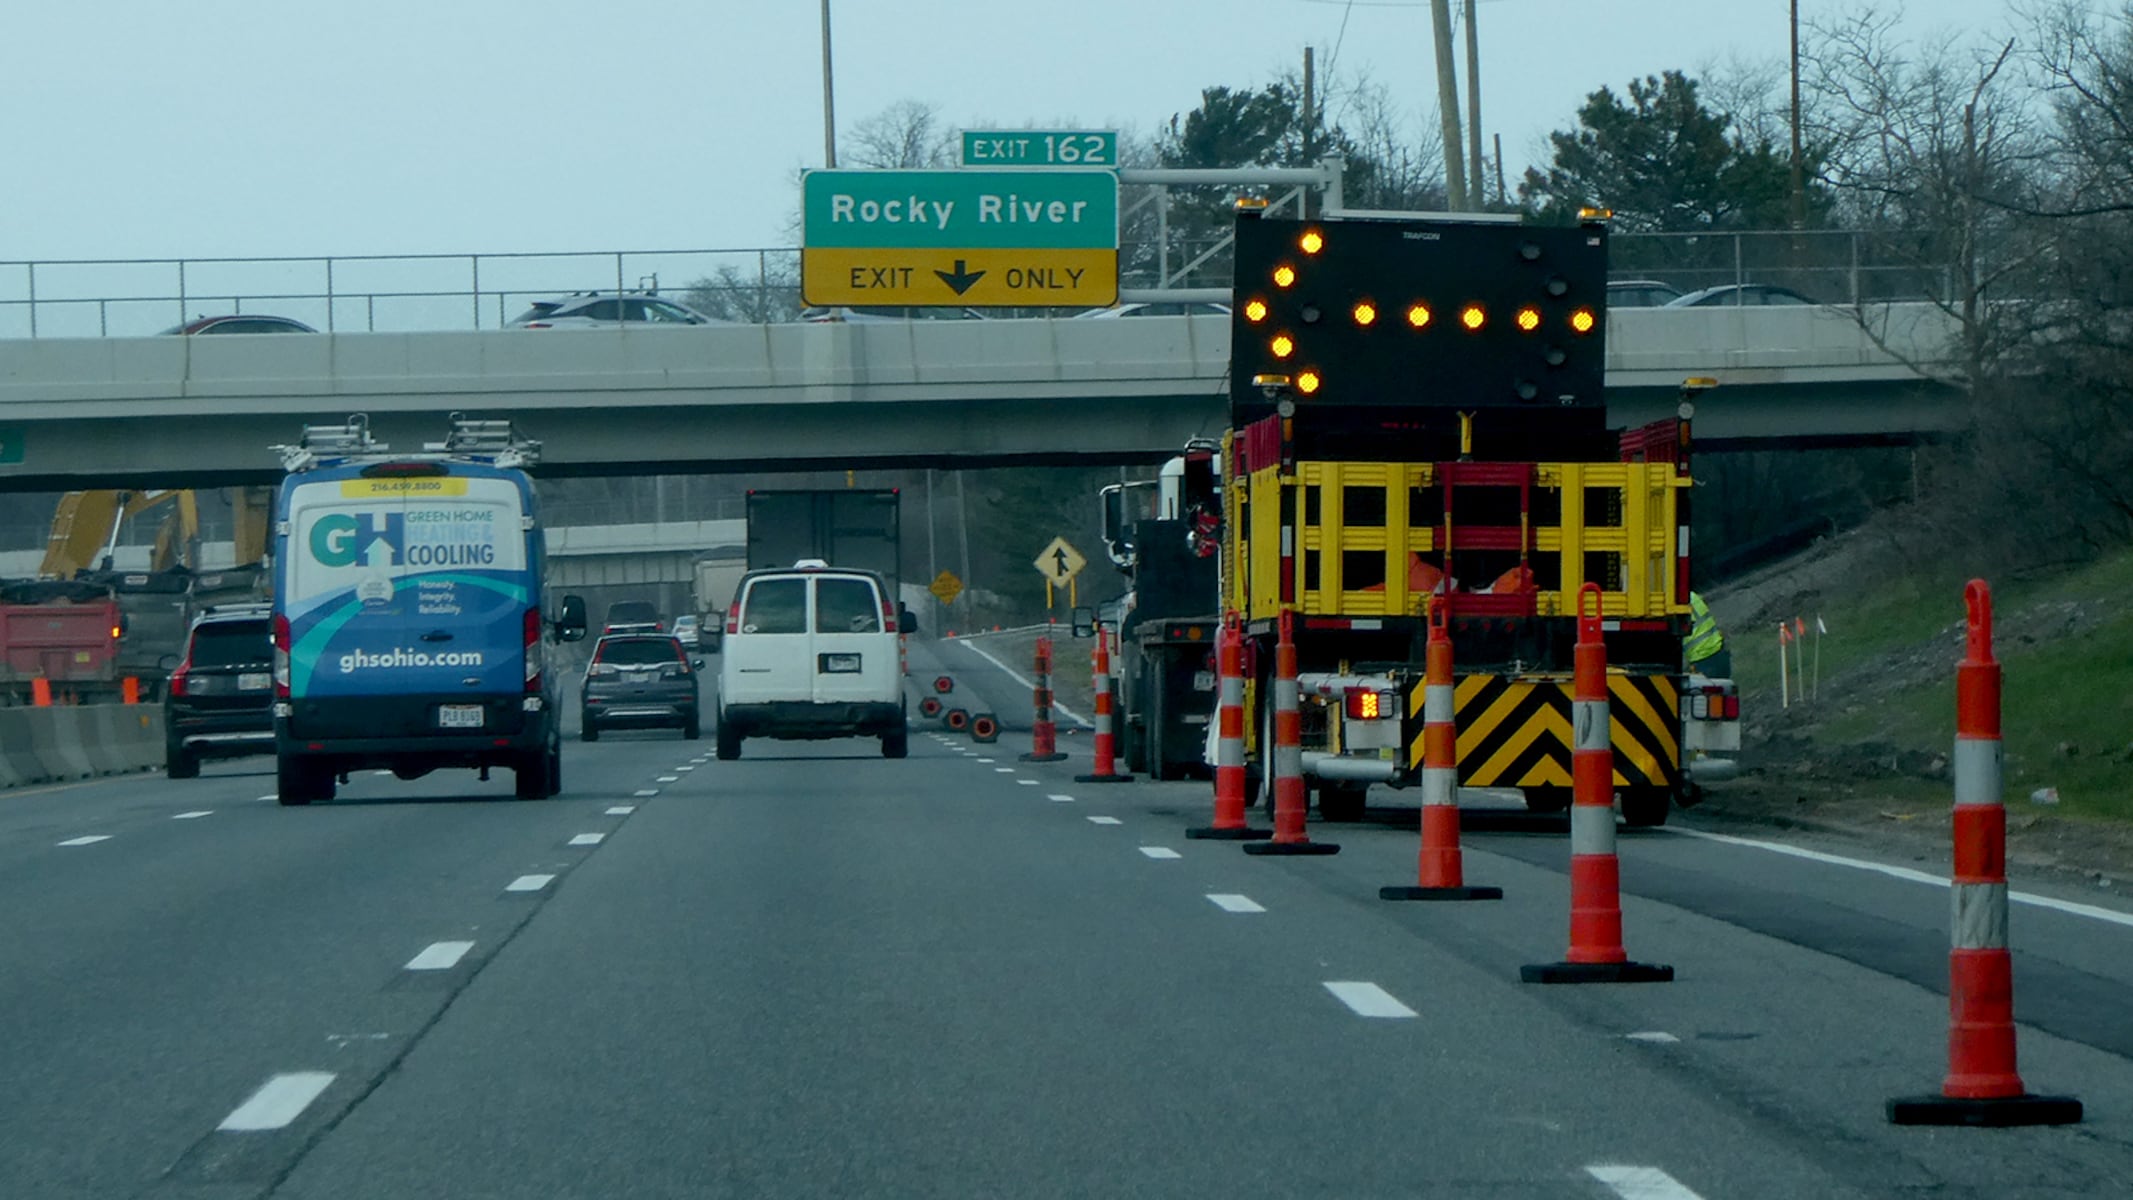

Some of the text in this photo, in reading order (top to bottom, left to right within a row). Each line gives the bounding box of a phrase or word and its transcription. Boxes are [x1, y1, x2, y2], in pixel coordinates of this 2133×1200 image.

[973, 135, 1105, 163] EXIT 162
[832, 193, 1087, 230] Rocky River
[851, 267, 1085, 289] EXIT ONLY
[406, 510, 493, 523] GREEN HOME
[310, 512, 404, 567] GH
[407, 523, 494, 543] HEATING &
[407, 544, 494, 566] COOLING
[340, 647, 483, 673] ghsohio.com
